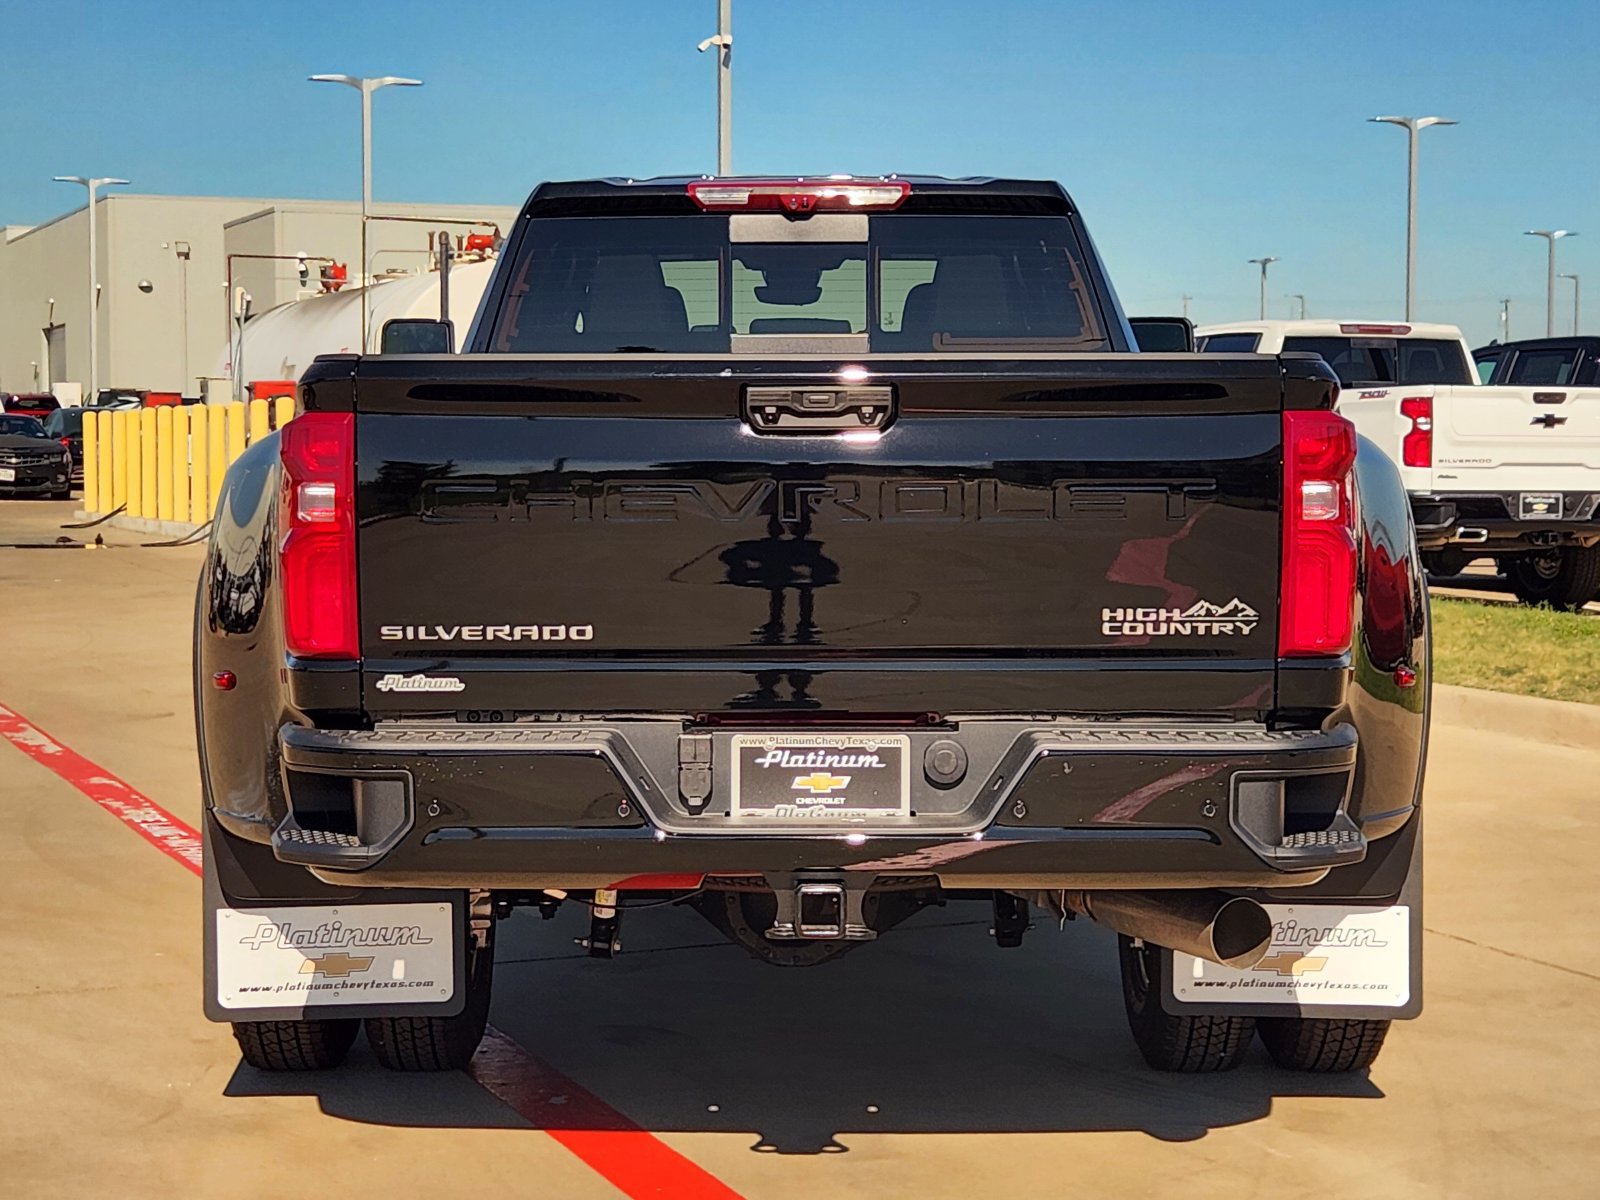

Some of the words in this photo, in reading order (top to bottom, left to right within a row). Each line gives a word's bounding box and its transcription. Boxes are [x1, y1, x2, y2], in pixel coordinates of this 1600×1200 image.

[420, 478, 1217, 522] CHEVROLET
[1102, 608, 1181, 621] HIGH
[380, 624, 594, 641] SILVERADO
[1102, 622, 1257, 635] COUNTRY
[376, 674, 465, 692] Platinum
[739, 736, 903, 748] wwwPlatinumChevyTexas.com
[754, 750, 887, 769] Platinum
[796, 797, 847, 805] CHEVROLET
[239, 920, 433, 950] Platinum
[1270, 919, 1389, 947] tinum
[239, 978, 435, 993] www.platinumchevytexas.com
[1193, 978, 1389, 990] www.platinumchevytexas.com
